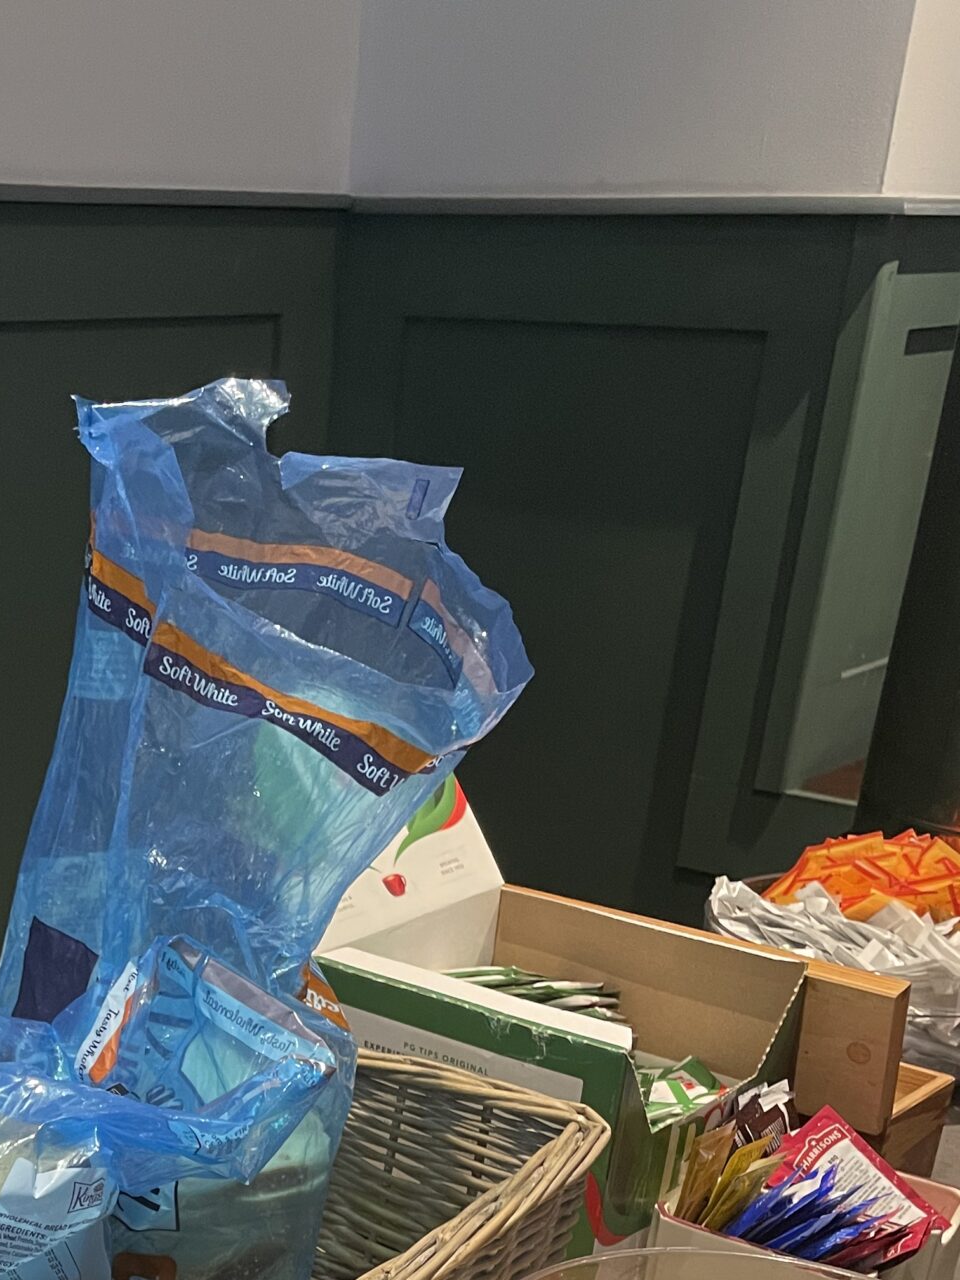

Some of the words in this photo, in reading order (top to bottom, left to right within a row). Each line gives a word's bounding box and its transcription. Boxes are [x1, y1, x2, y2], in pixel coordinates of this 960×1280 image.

[125, 607, 151, 639] Soft
[159, 655, 191, 686] Soft
[191, 673, 239, 706] White
[297, 716, 341, 751] White
[356, 753, 388, 788] Soft
[95, 1008, 120, 1039] Tasty
[403, 1041, 416, 1052] PG
[418, 1046, 439, 1060] TIPS
[442, 1054, 489, 1076] ORIGINAL
[800, 1130, 842, 1174] HARRISONS
